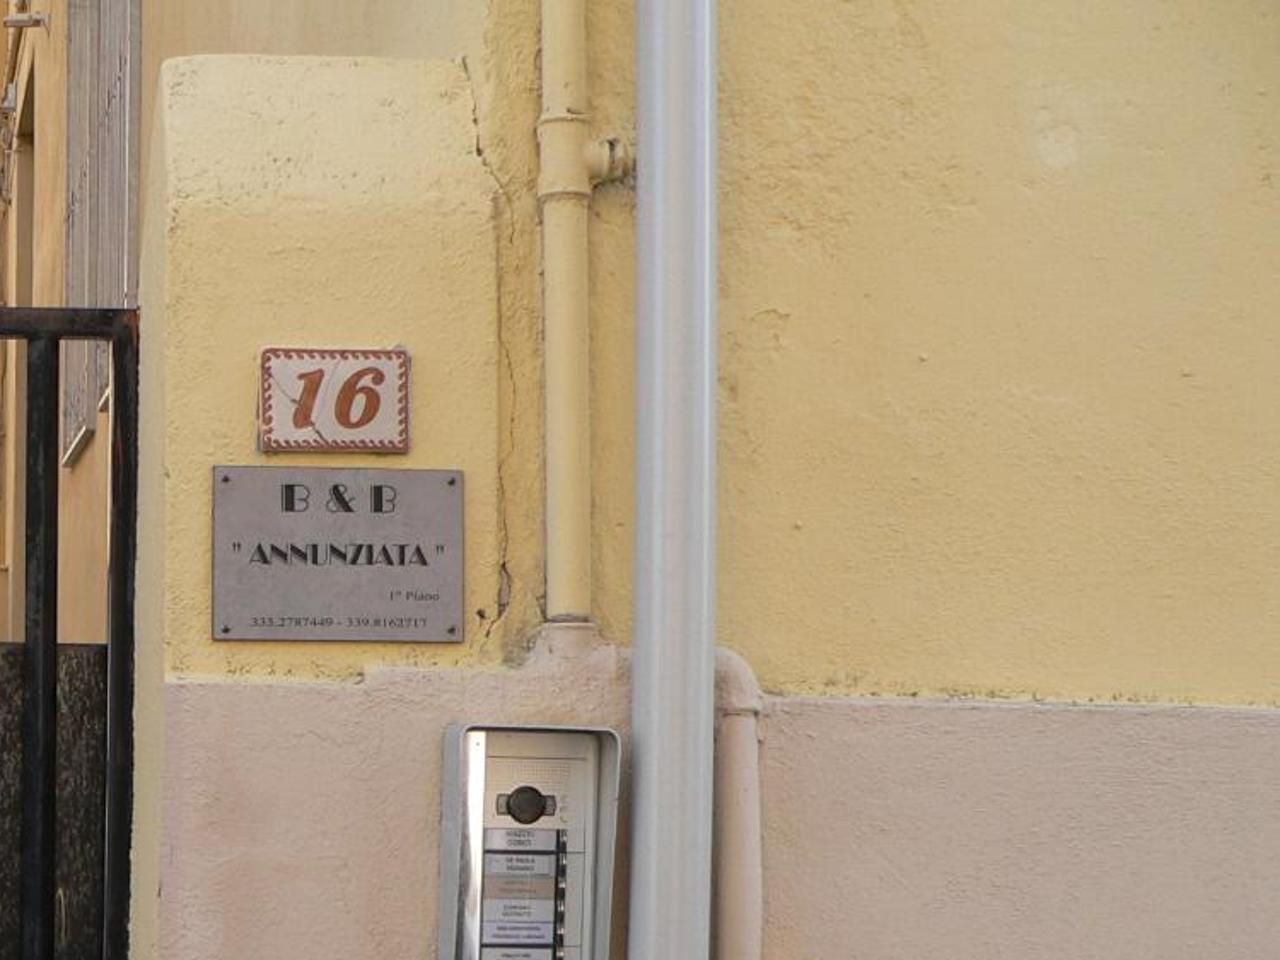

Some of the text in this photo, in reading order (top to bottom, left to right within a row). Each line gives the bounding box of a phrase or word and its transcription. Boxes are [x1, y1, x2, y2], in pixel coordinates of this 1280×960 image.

[292, 367, 386, 431] 16
[281, 484, 398, 513] B & B
